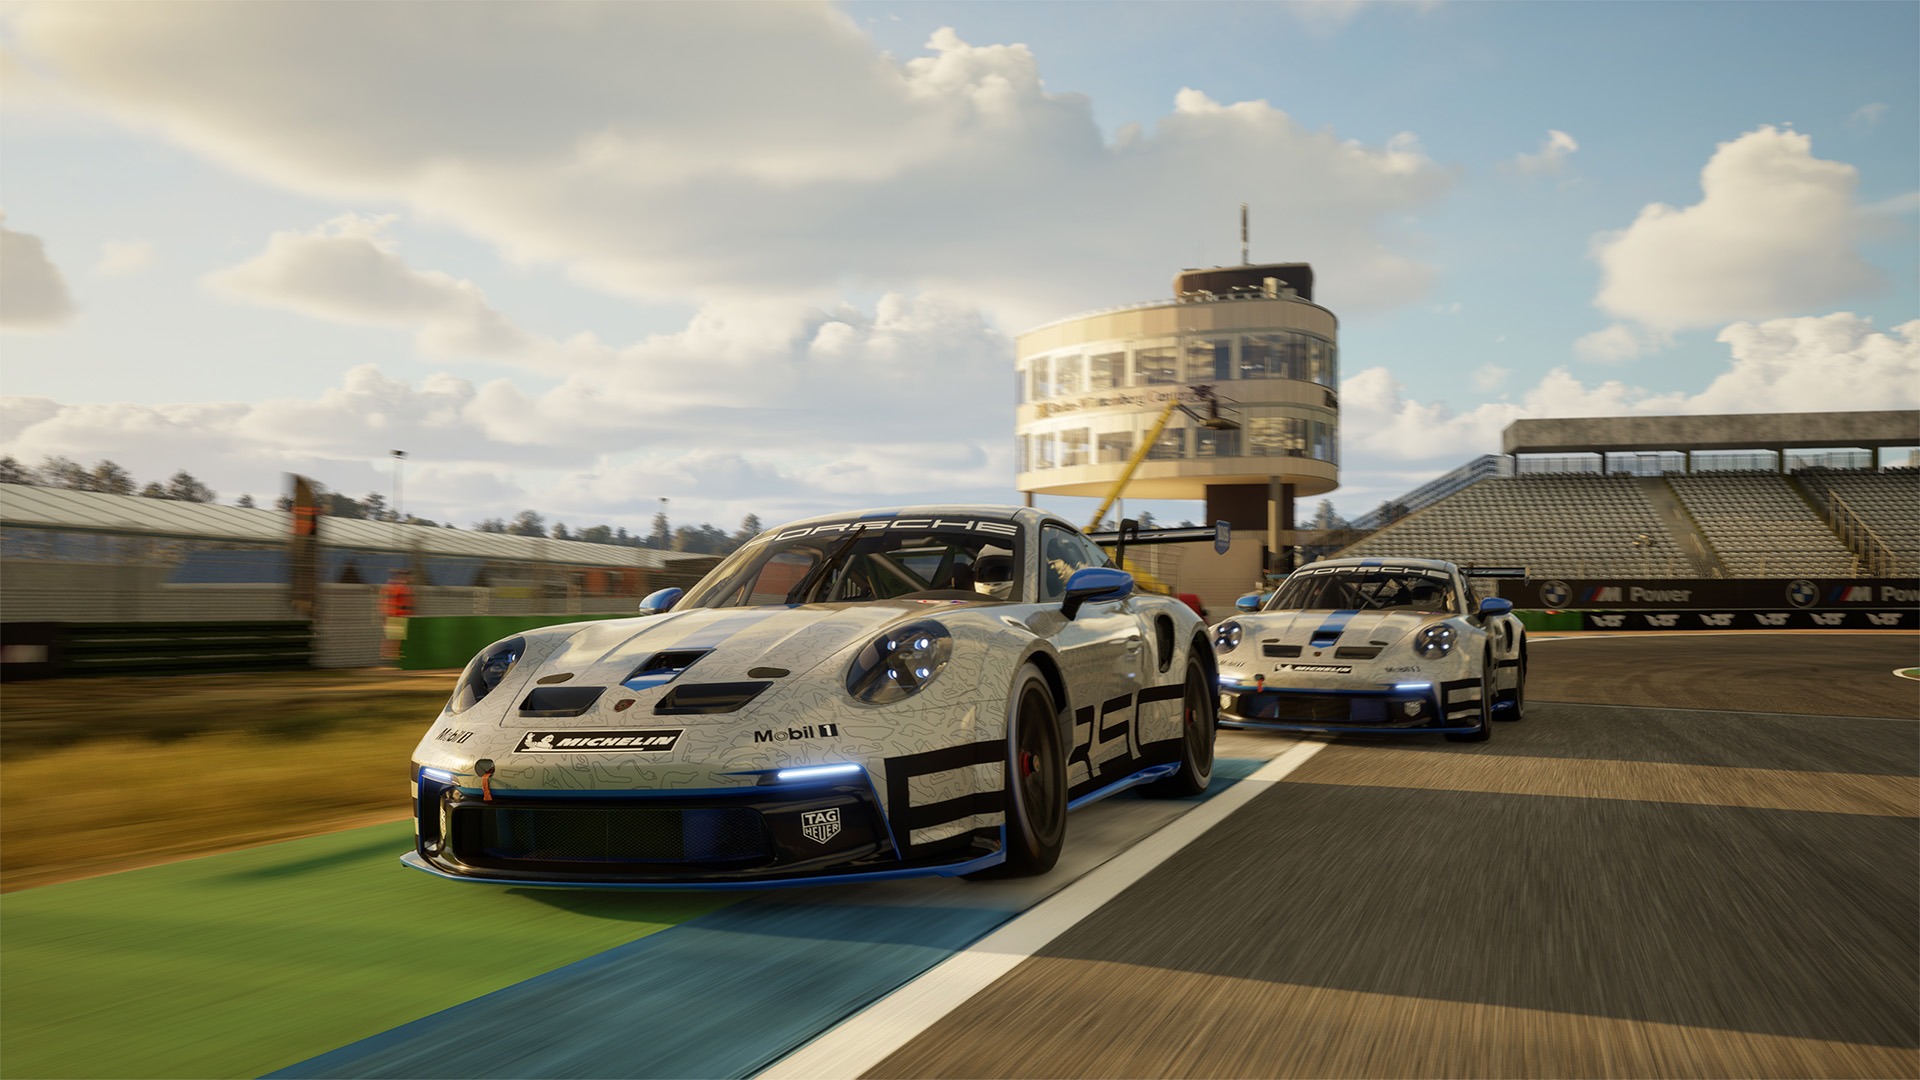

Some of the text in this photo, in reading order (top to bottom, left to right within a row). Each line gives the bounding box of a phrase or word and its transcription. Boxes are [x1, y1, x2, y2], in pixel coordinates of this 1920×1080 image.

[742, 519, 1018, 551] PORSCHE
[1630, 586, 1692, 602] Power
[556, 736, 676, 747] MICHELIN
[754, 726, 814, 743] Mobil
[804, 810, 837, 825] TAG
[805, 823, 839, 841] HEUER
